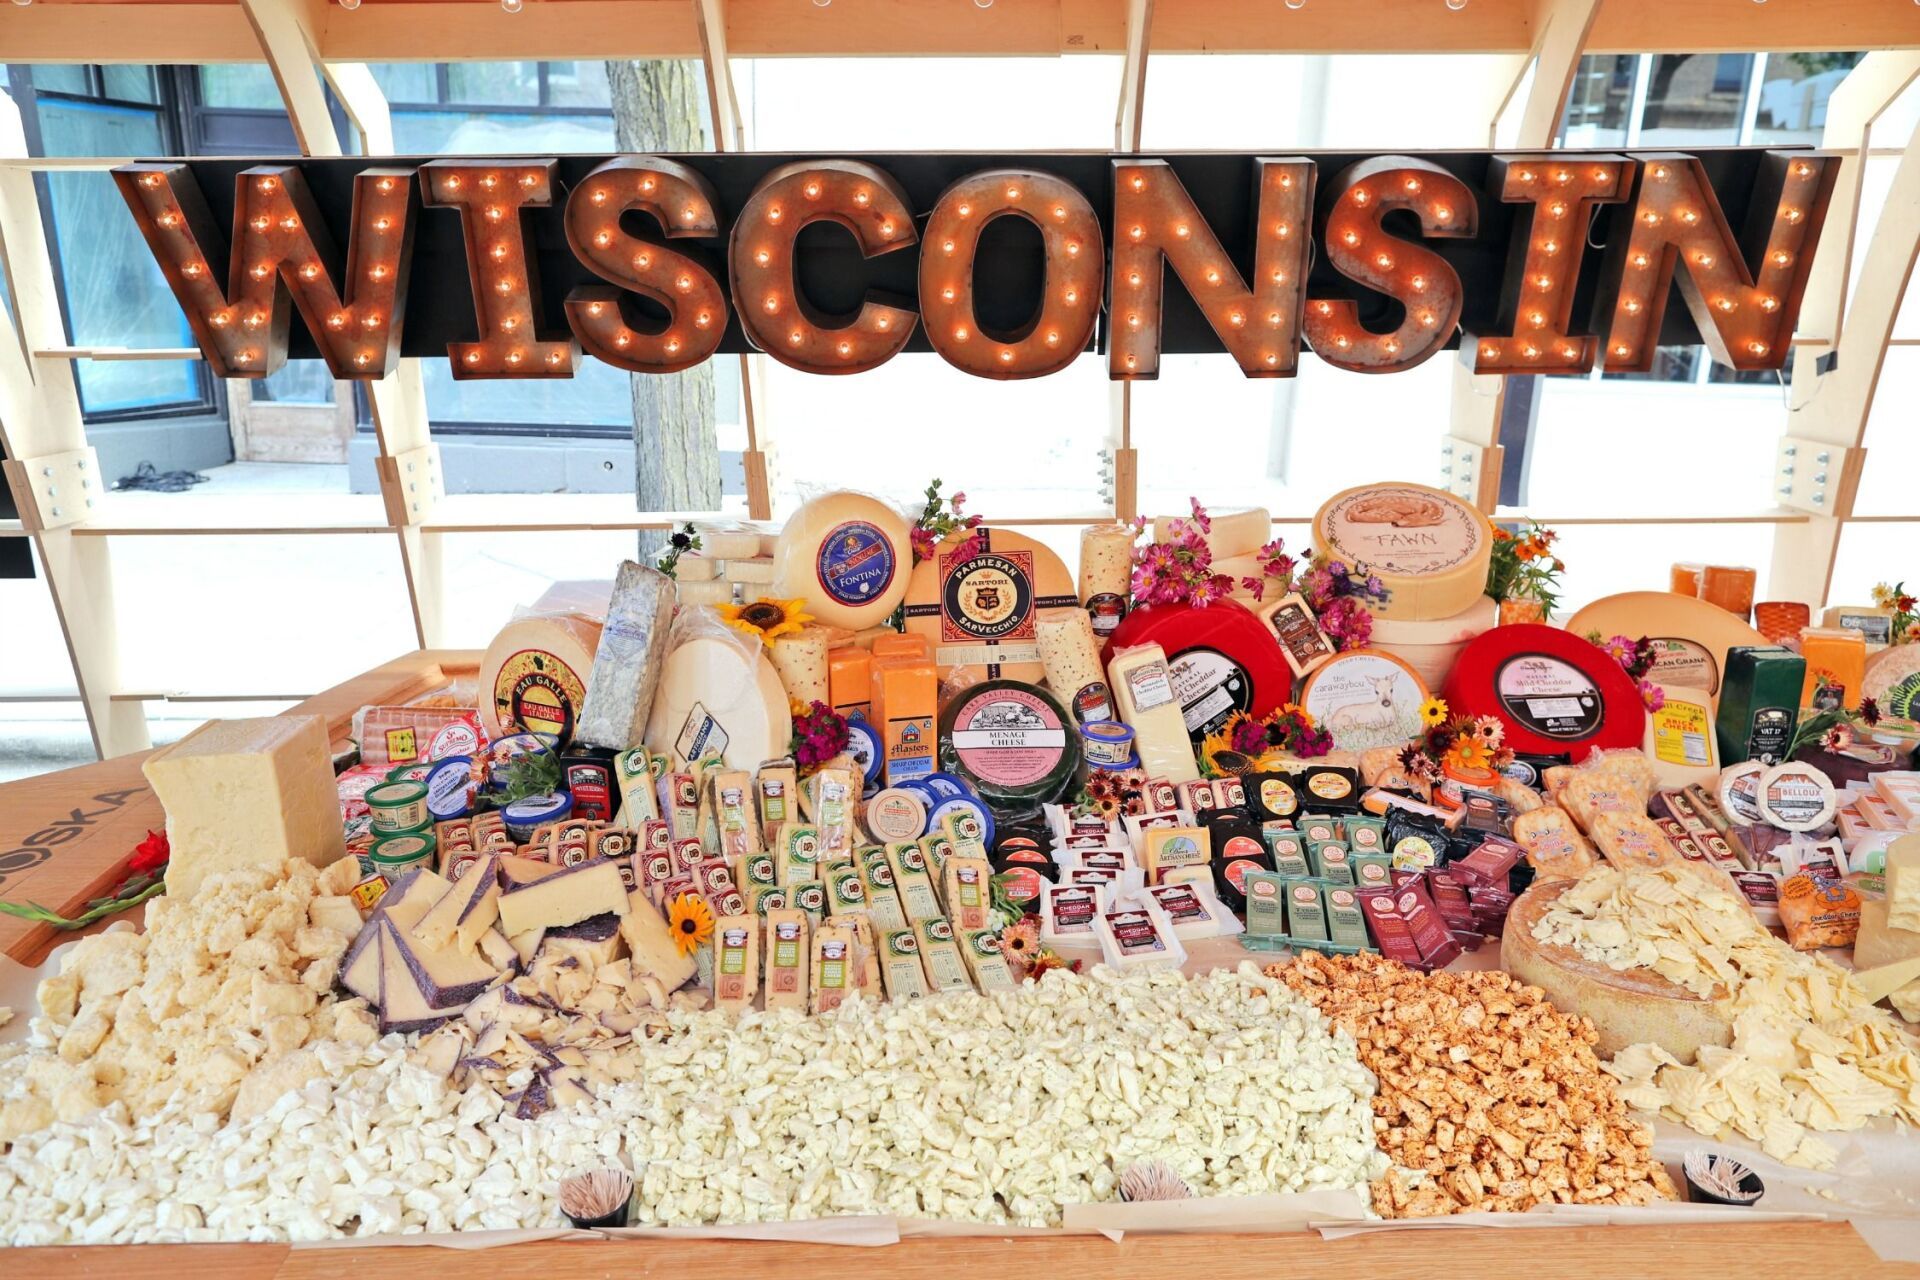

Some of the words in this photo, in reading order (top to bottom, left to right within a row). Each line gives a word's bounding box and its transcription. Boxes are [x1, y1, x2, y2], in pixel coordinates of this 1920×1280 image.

[111, 154, 1842, 380] WISCONSIN
[1377, 533, 1437, 546] FAWN
[840, 568, 882, 588] FONTINA
[955, 558, 1018, 580] PARMESAN
[959, 615, 1018, 634] SARVECCHIO
[516, 676, 533, 695] EAU
[536, 675, 568, 703] GALLE
[1781, 788, 1821, 796] BELLOUX
[1119, 927, 1150, 936] CHEDDAR
